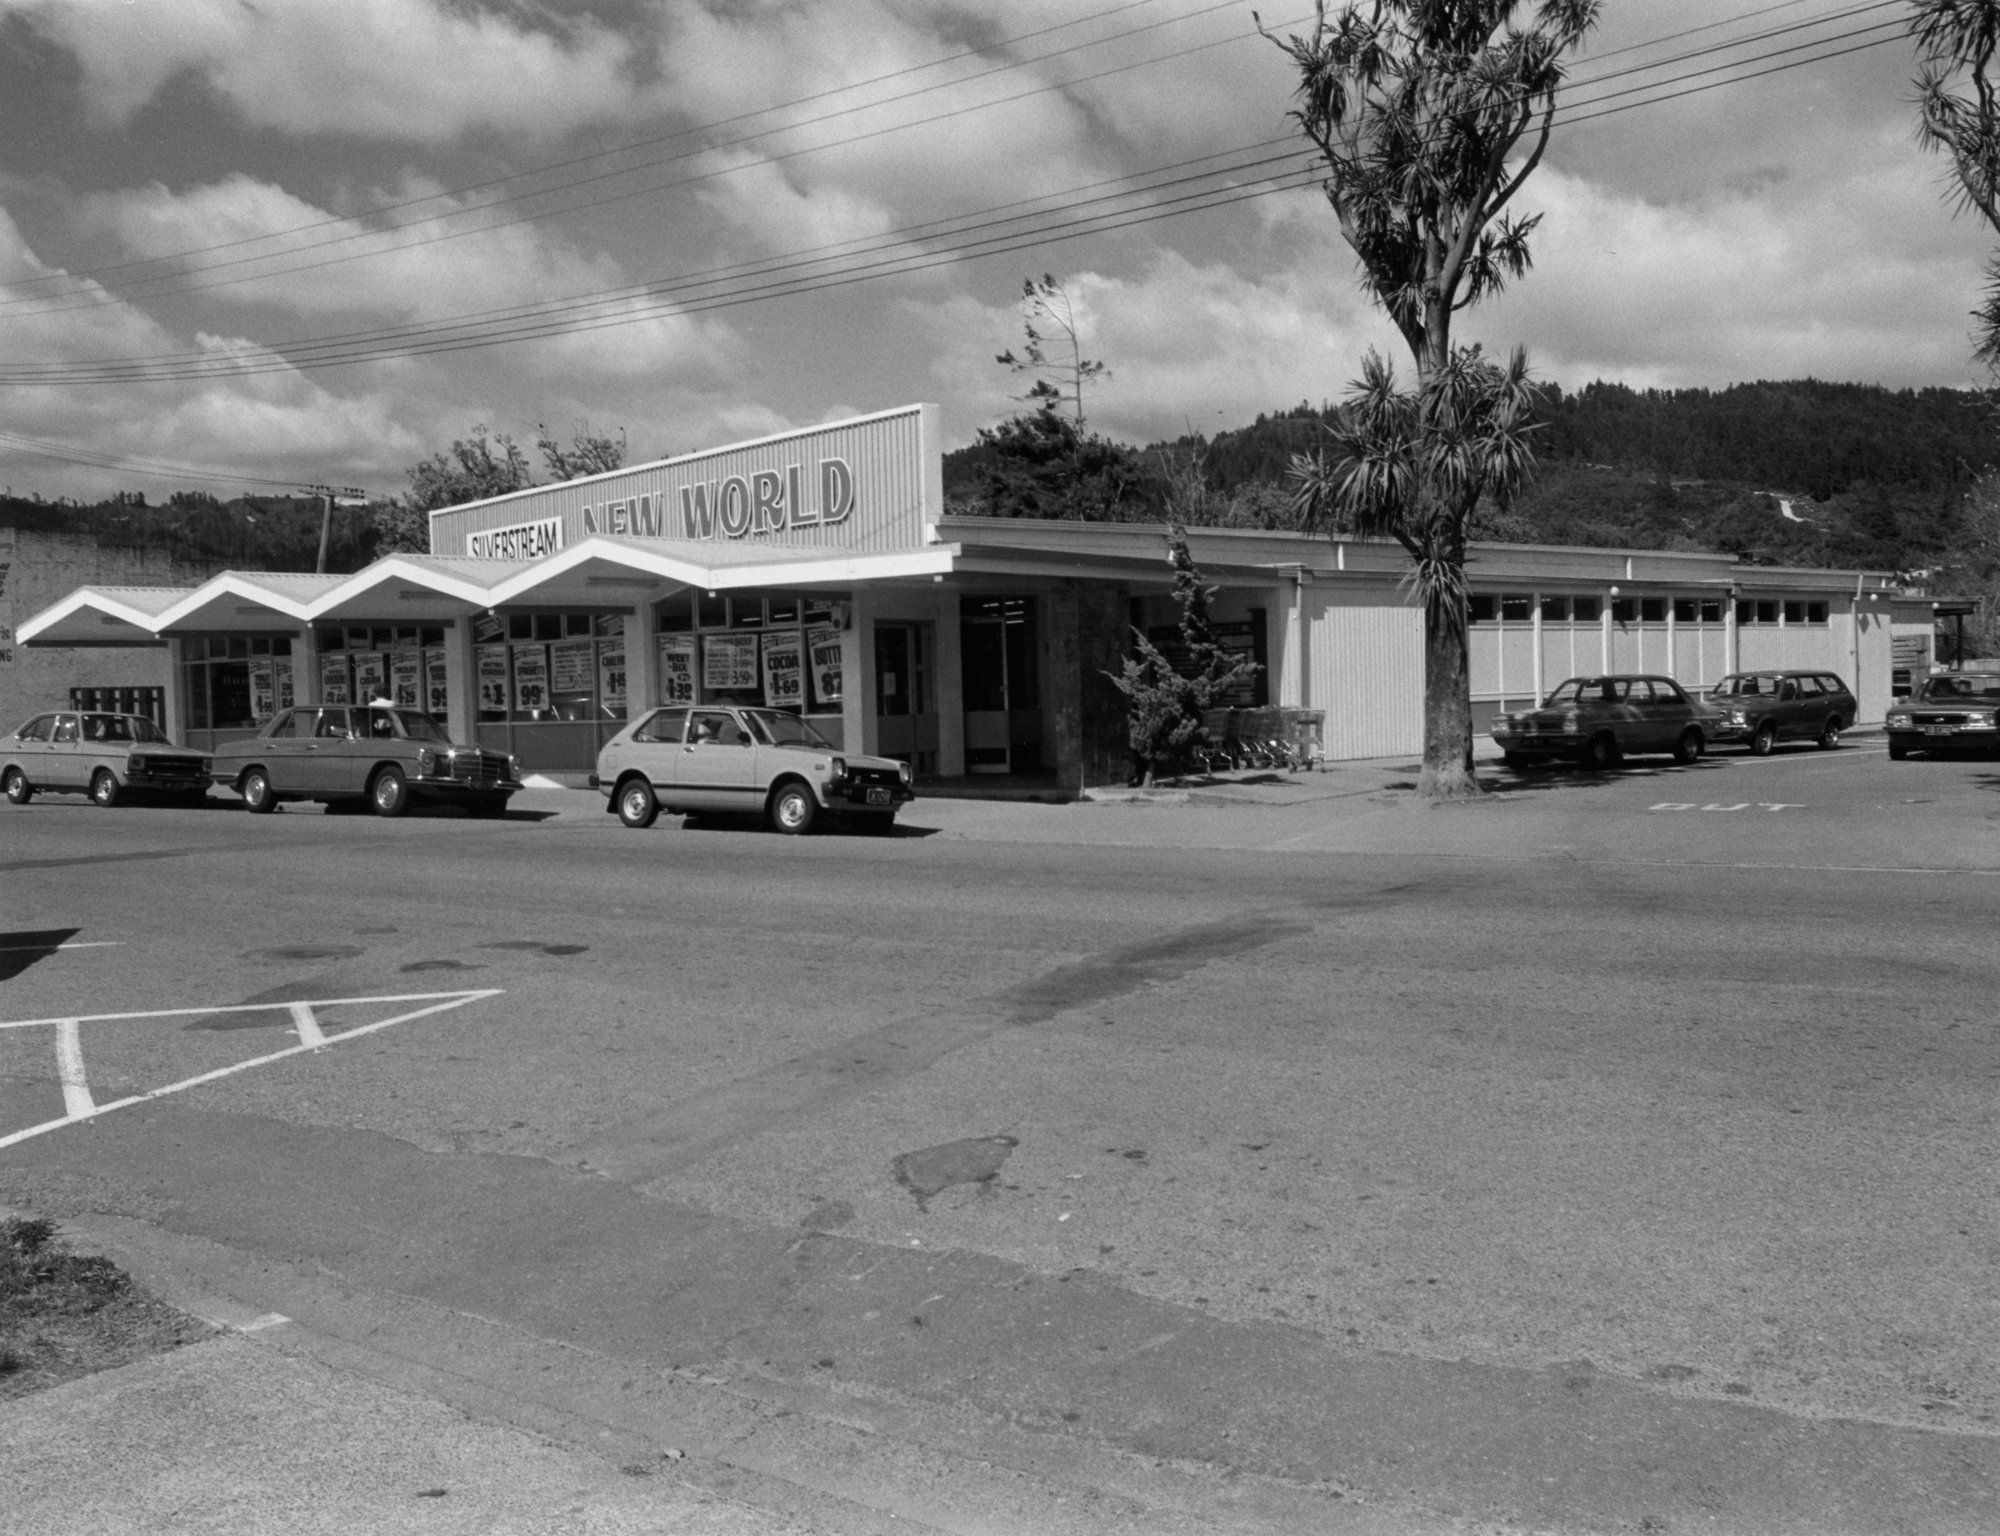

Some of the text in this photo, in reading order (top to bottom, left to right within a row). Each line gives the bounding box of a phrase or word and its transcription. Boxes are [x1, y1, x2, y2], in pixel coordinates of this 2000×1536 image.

[582, 457, 854, 540] NEW WORLD
[472, 521, 557, 559] SILVERSTREAM
[768, 655, 799, 671] COCOA
[1648, 802, 1808, 812] OUT
